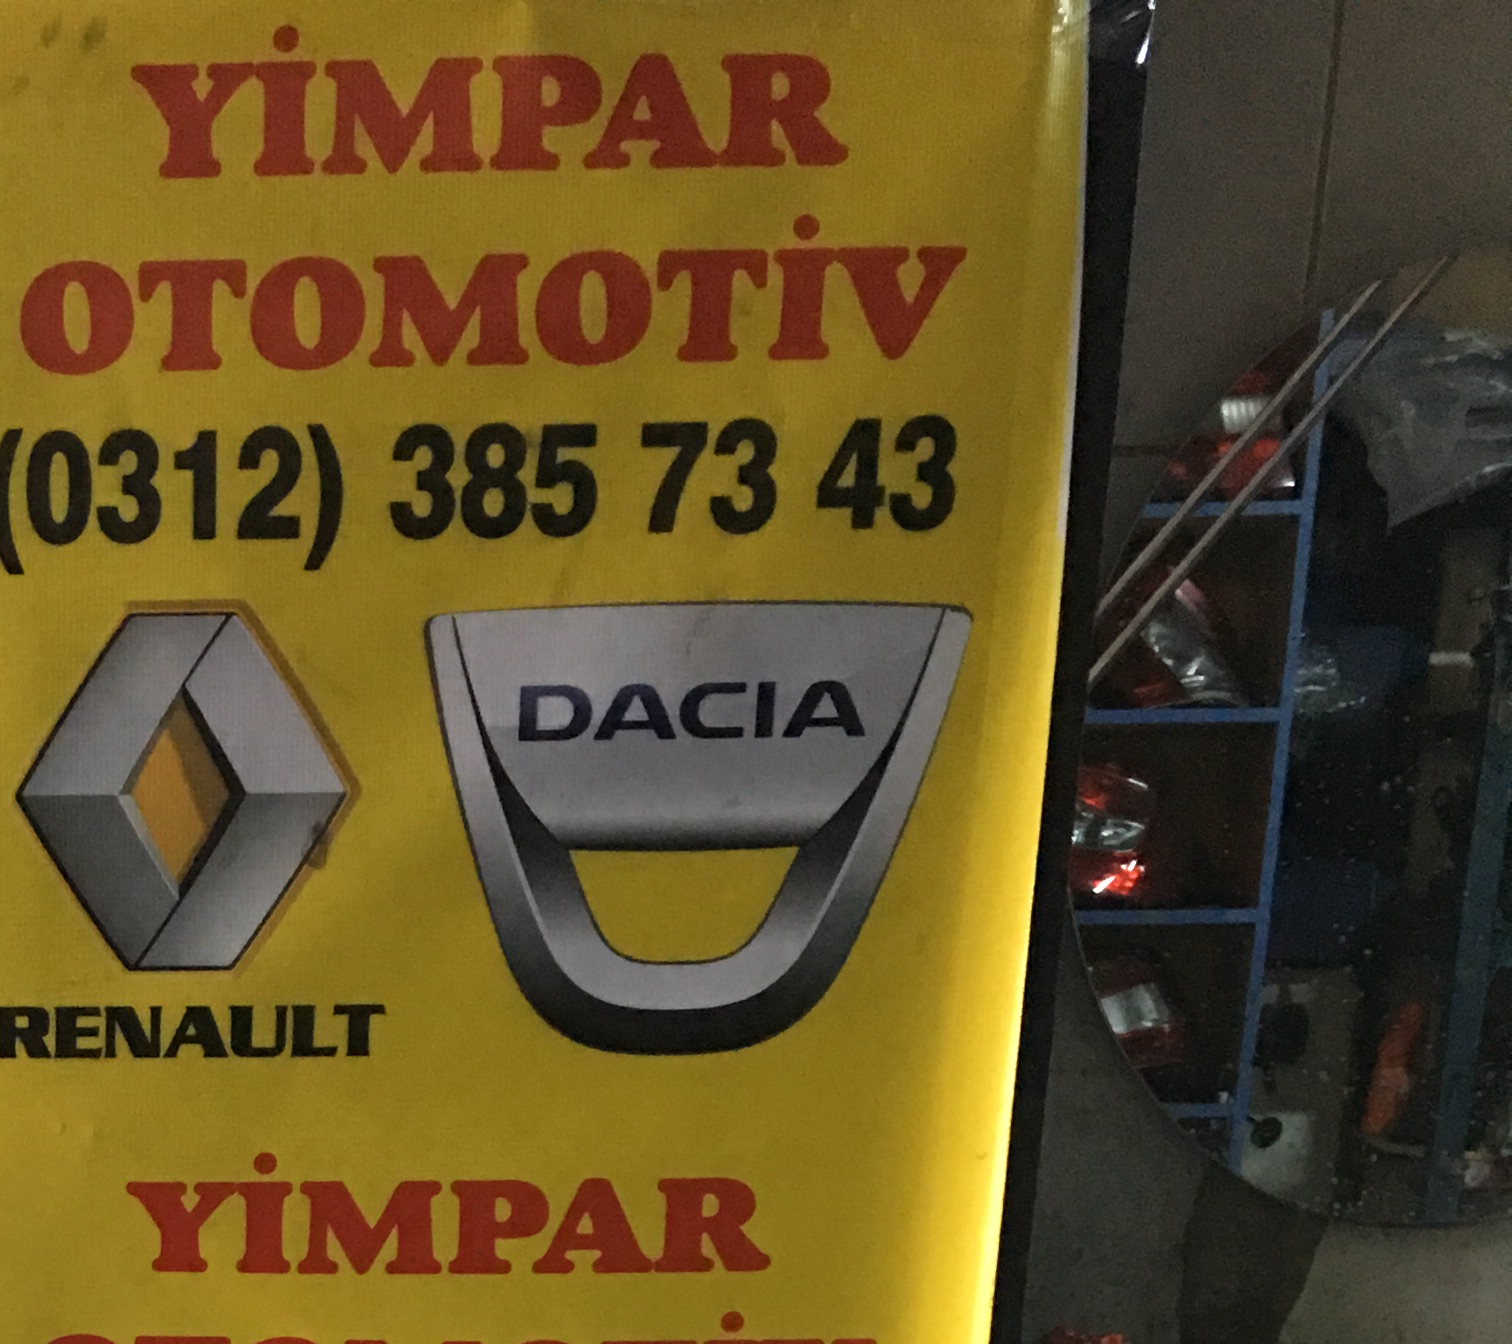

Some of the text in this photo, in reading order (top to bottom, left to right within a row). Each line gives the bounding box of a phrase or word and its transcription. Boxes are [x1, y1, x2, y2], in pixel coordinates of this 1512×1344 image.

[134, 28, 845, 179] YİMPAR
[21, 216, 963, 374] OTOMOTİV
[386, 421, 600, 543] 385
[638, 416, 779, 538] 73
[814, 412, 956, 534] 43
[518, 680, 866, 742] DACIA
[127, 1154, 768, 1274] YİMPAR
